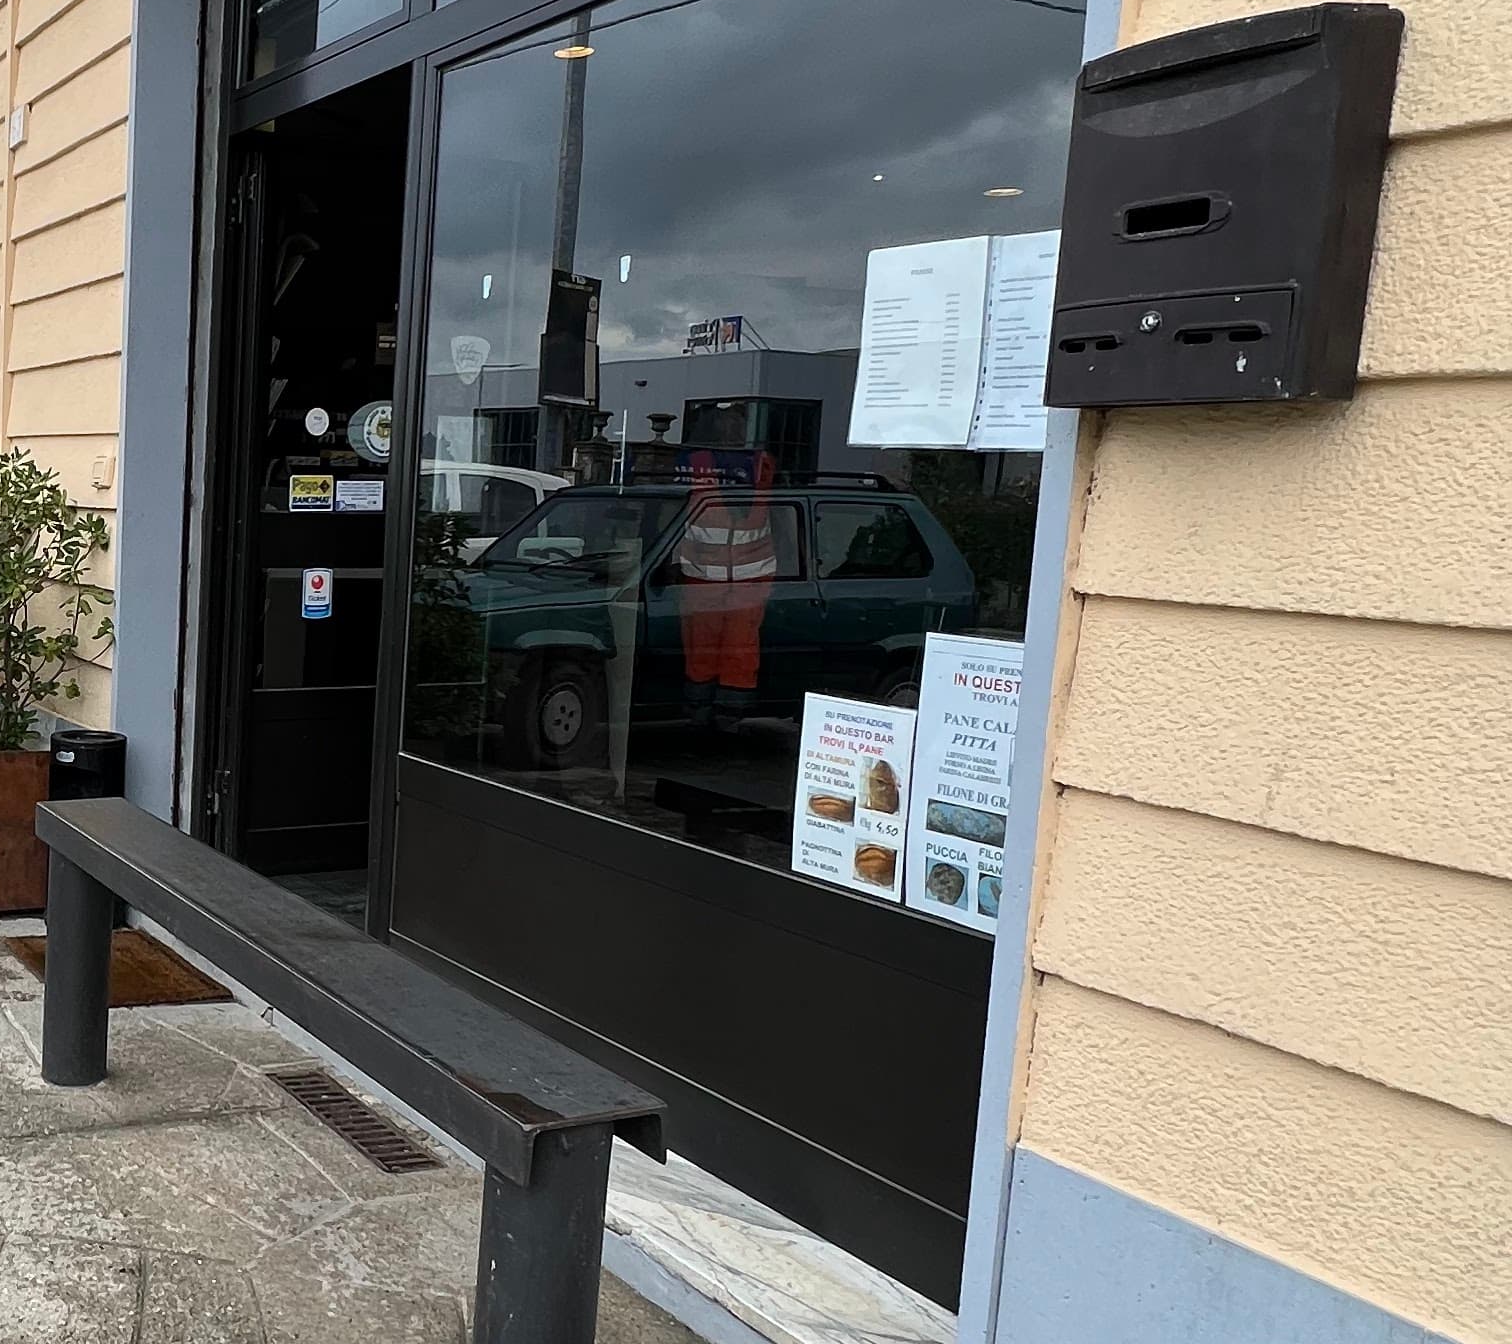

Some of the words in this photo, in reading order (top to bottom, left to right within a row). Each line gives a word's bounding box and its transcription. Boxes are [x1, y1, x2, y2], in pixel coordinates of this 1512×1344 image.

[961, 661, 985, 672] SOLO
[953, 672, 968, 687] IN
[972, 675, 1022, 695] QUEST
[972, 691, 1008, 705] TROVI
[944, 712, 980, 730] PANE
[983, 719, 1016, 736] CAL
[834, 725, 872, 741] QUESTO
[874, 733, 894, 744] BAR
[951, 733, 997, 752] PITTA
[819, 736, 845, 749] TROVI
[858, 743, 884, 756] PANE
[937, 783, 975, 802] FILONE
[977, 791, 988, 805] DI
[991, 795, 1009, 809] GR
[926, 842, 968, 863] PUCCIA
[978, 847, 1003, 861] FILO
